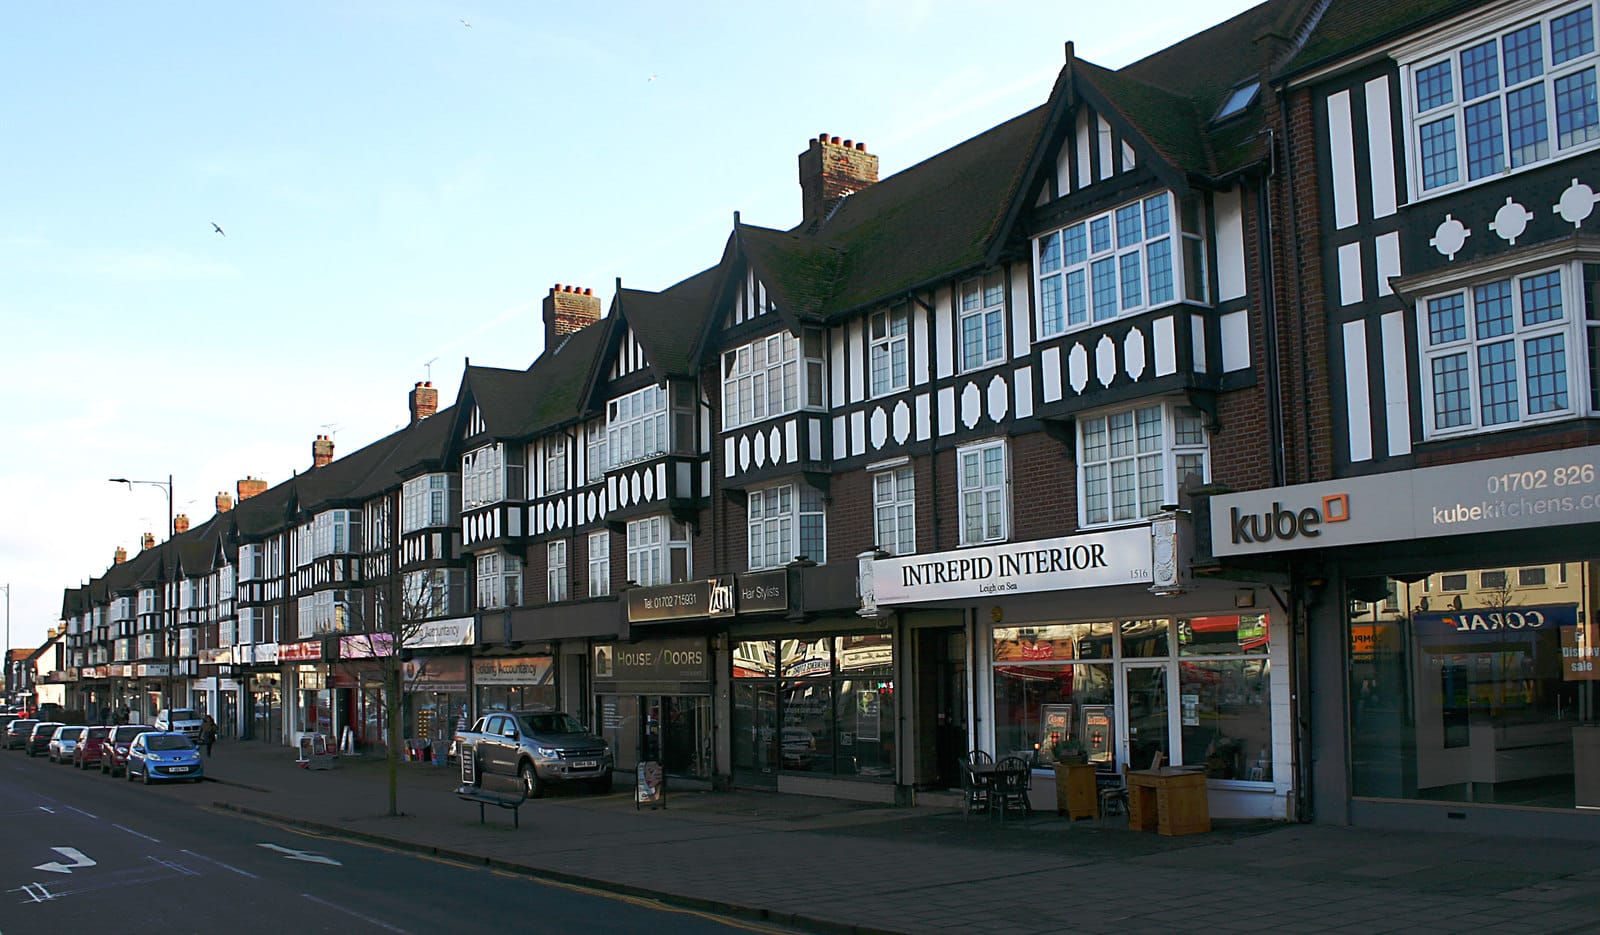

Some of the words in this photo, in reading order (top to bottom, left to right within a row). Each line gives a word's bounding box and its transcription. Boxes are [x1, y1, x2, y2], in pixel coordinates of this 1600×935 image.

[1487, 469, 1548, 494] 01702
[1553, 463, 1595, 487] 826
[1230, 502, 1322, 544] kube
[902, 556, 993, 588] INTREPID
[998, 543, 1108, 578] INTERIOR
[1130, 569, 1148, 579] 1516
[742, 587, 755, 600] Hair
[756, 586, 780, 601] Stylists
[979, 583, 996, 593] Leigh
[1007, 582, 1018, 591] Sea
[653, 595, 673, 609] 01702
[617, 652, 652, 666] HOUSE
[663, 649, 703, 665] DOORS
[1571, 660, 1593, 672] sale
